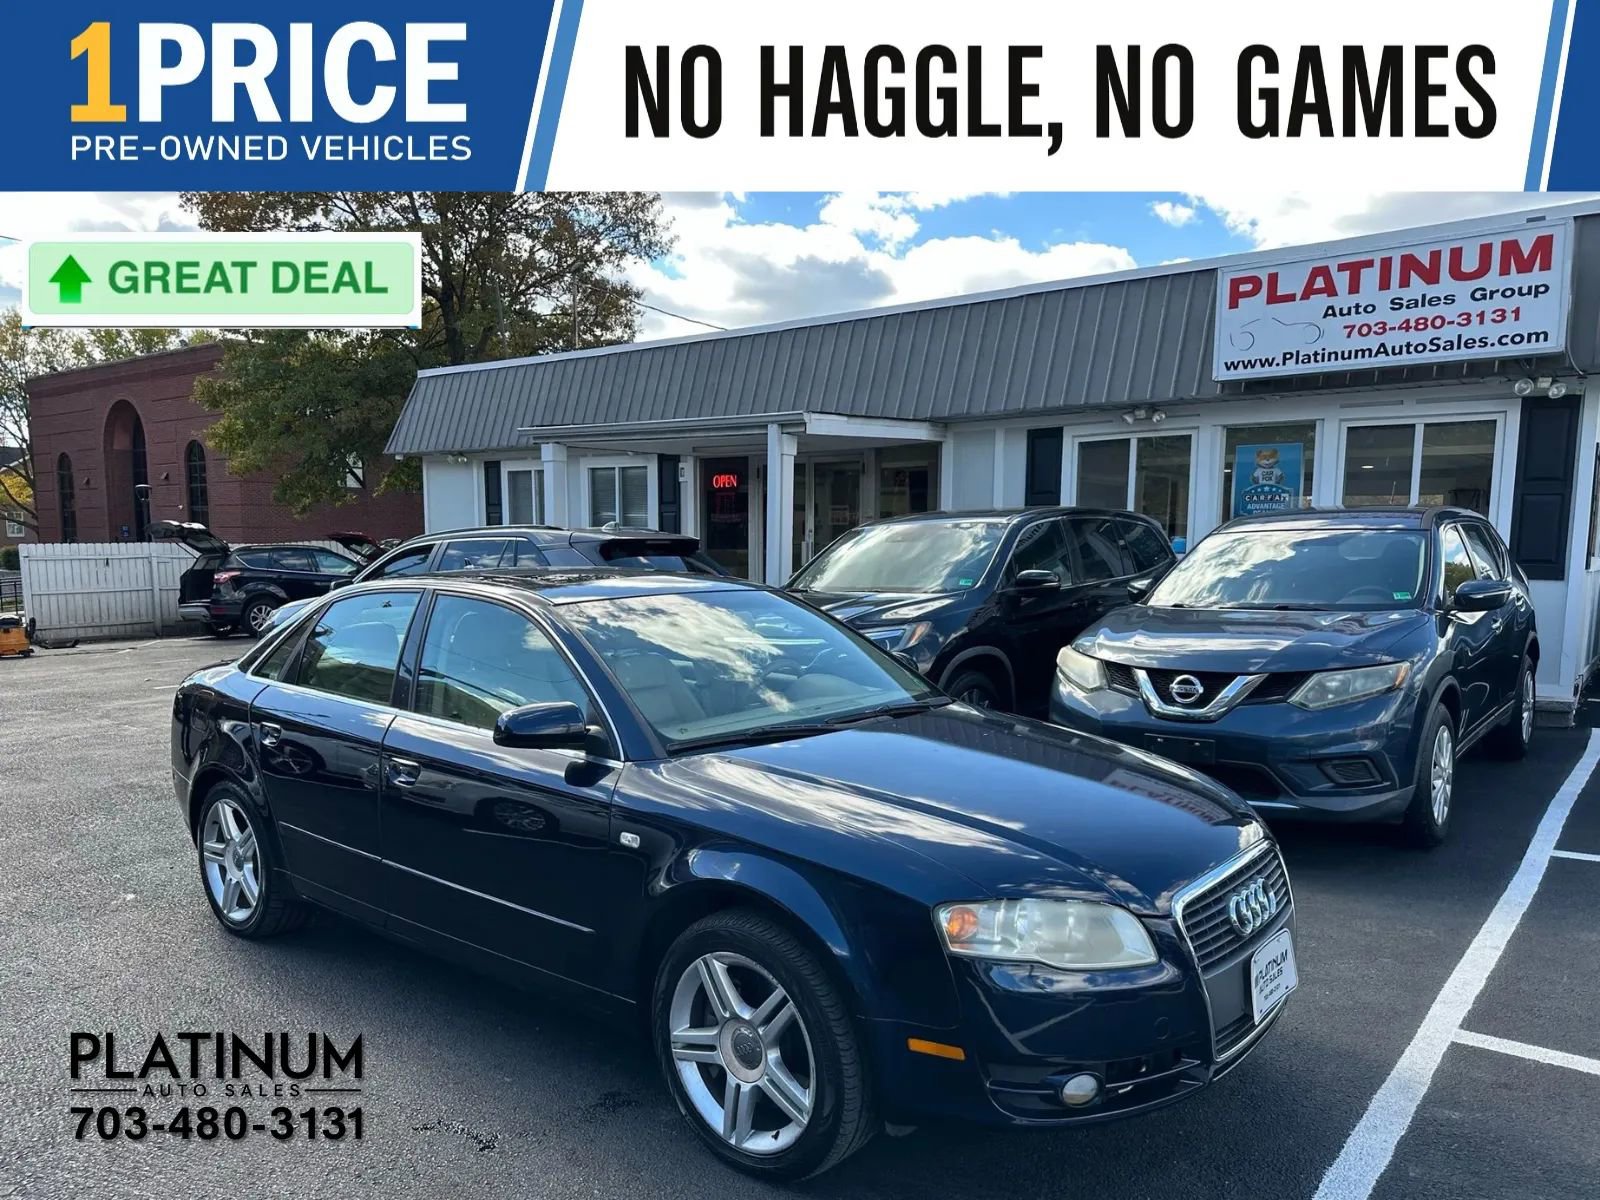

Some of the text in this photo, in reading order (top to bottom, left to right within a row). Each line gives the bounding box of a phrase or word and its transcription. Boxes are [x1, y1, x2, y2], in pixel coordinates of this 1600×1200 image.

[1227, 233, 1554, 310] PLATINUM
[1322, 282, 1550, 319] Auto Sales Group
[1343, 306, 1522, 339] 703-480-3131
[1224, 328, 1549, 371] www.PlatinumAutoSales.com
[712, 474, 737, 488] OPEN
[1245, 494, 1289, 502] CARFAX
[1247, 502, 1286, 510] ADVANTAGE
